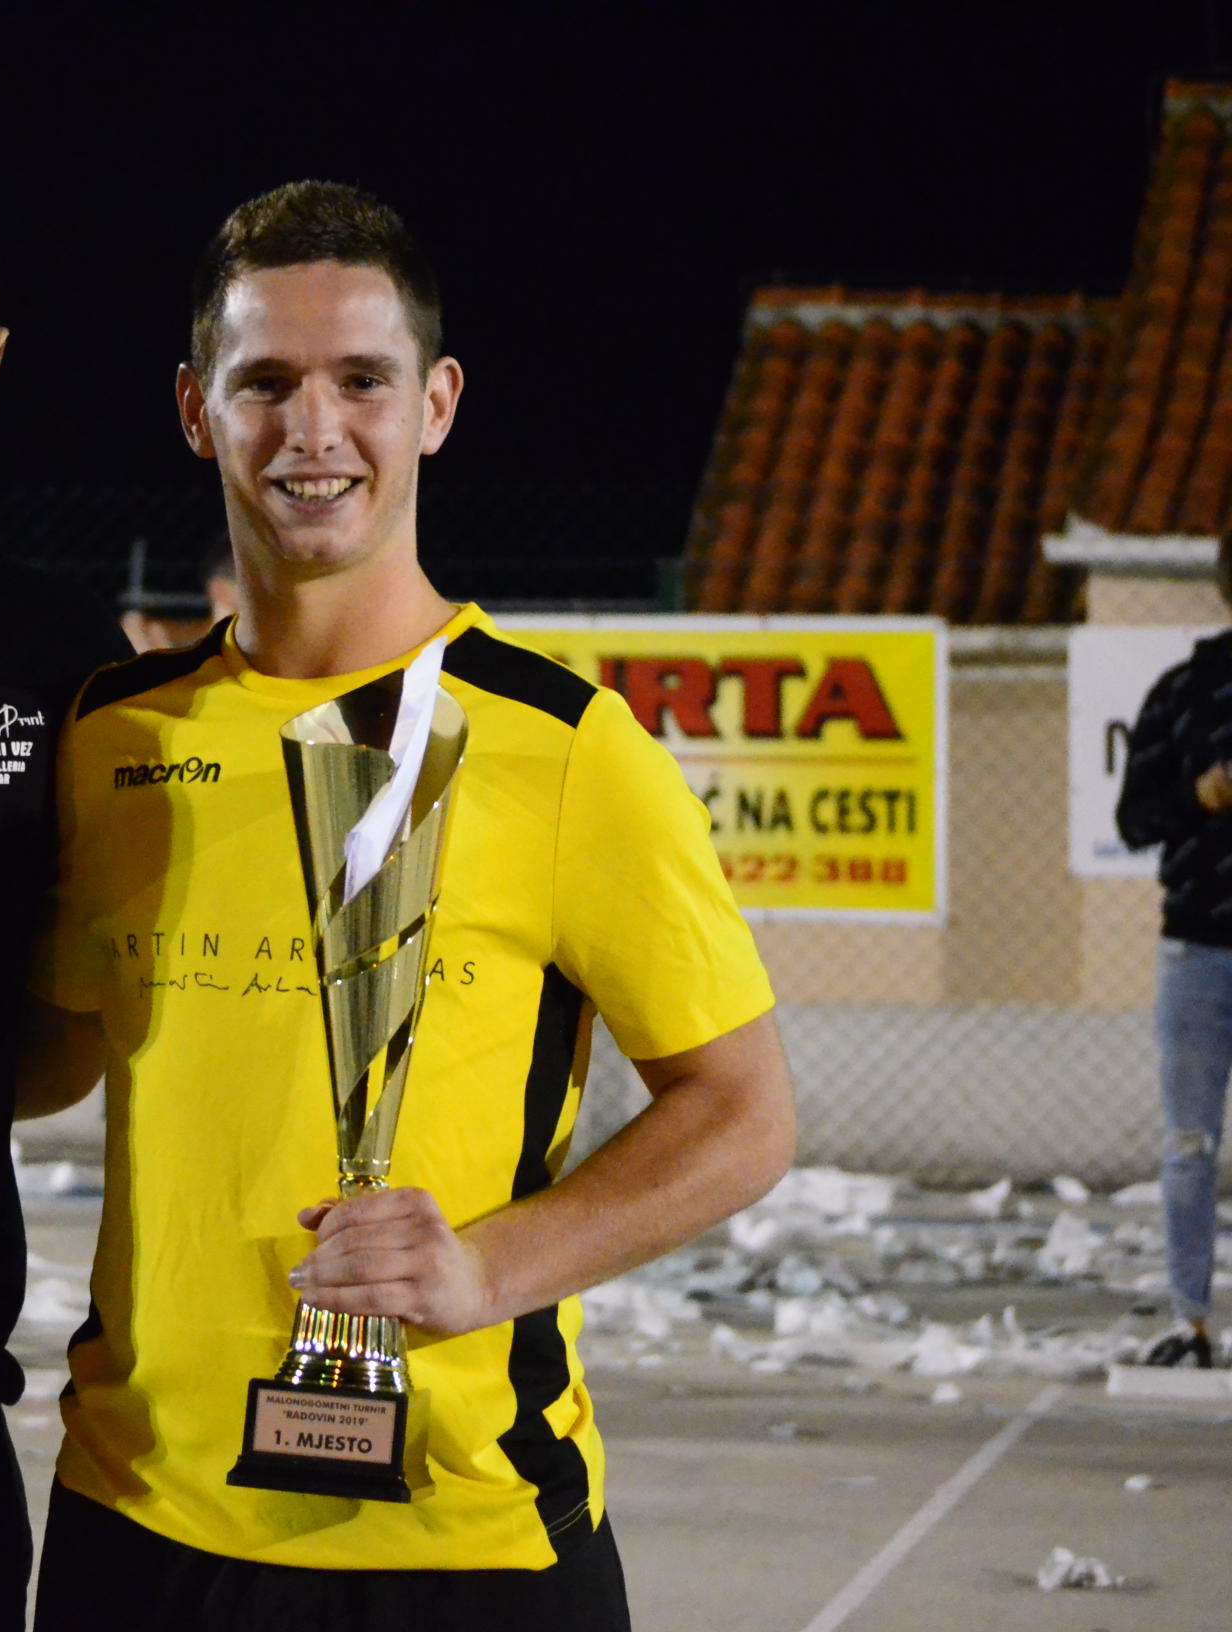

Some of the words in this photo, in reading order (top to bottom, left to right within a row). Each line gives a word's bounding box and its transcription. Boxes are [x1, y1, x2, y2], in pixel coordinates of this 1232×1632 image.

[10, 741, 33, 757] VEZ
[735, 785, 795, 835] NA
[808, 785, 918, 836] CESTI
[110, 932, 220, 961] ARTIN
[353, 1403, 386, 1414] TURNIR
[274, 1429, 290, 1446] 1.
[296, 1432, 373, 1454] MJESTO
